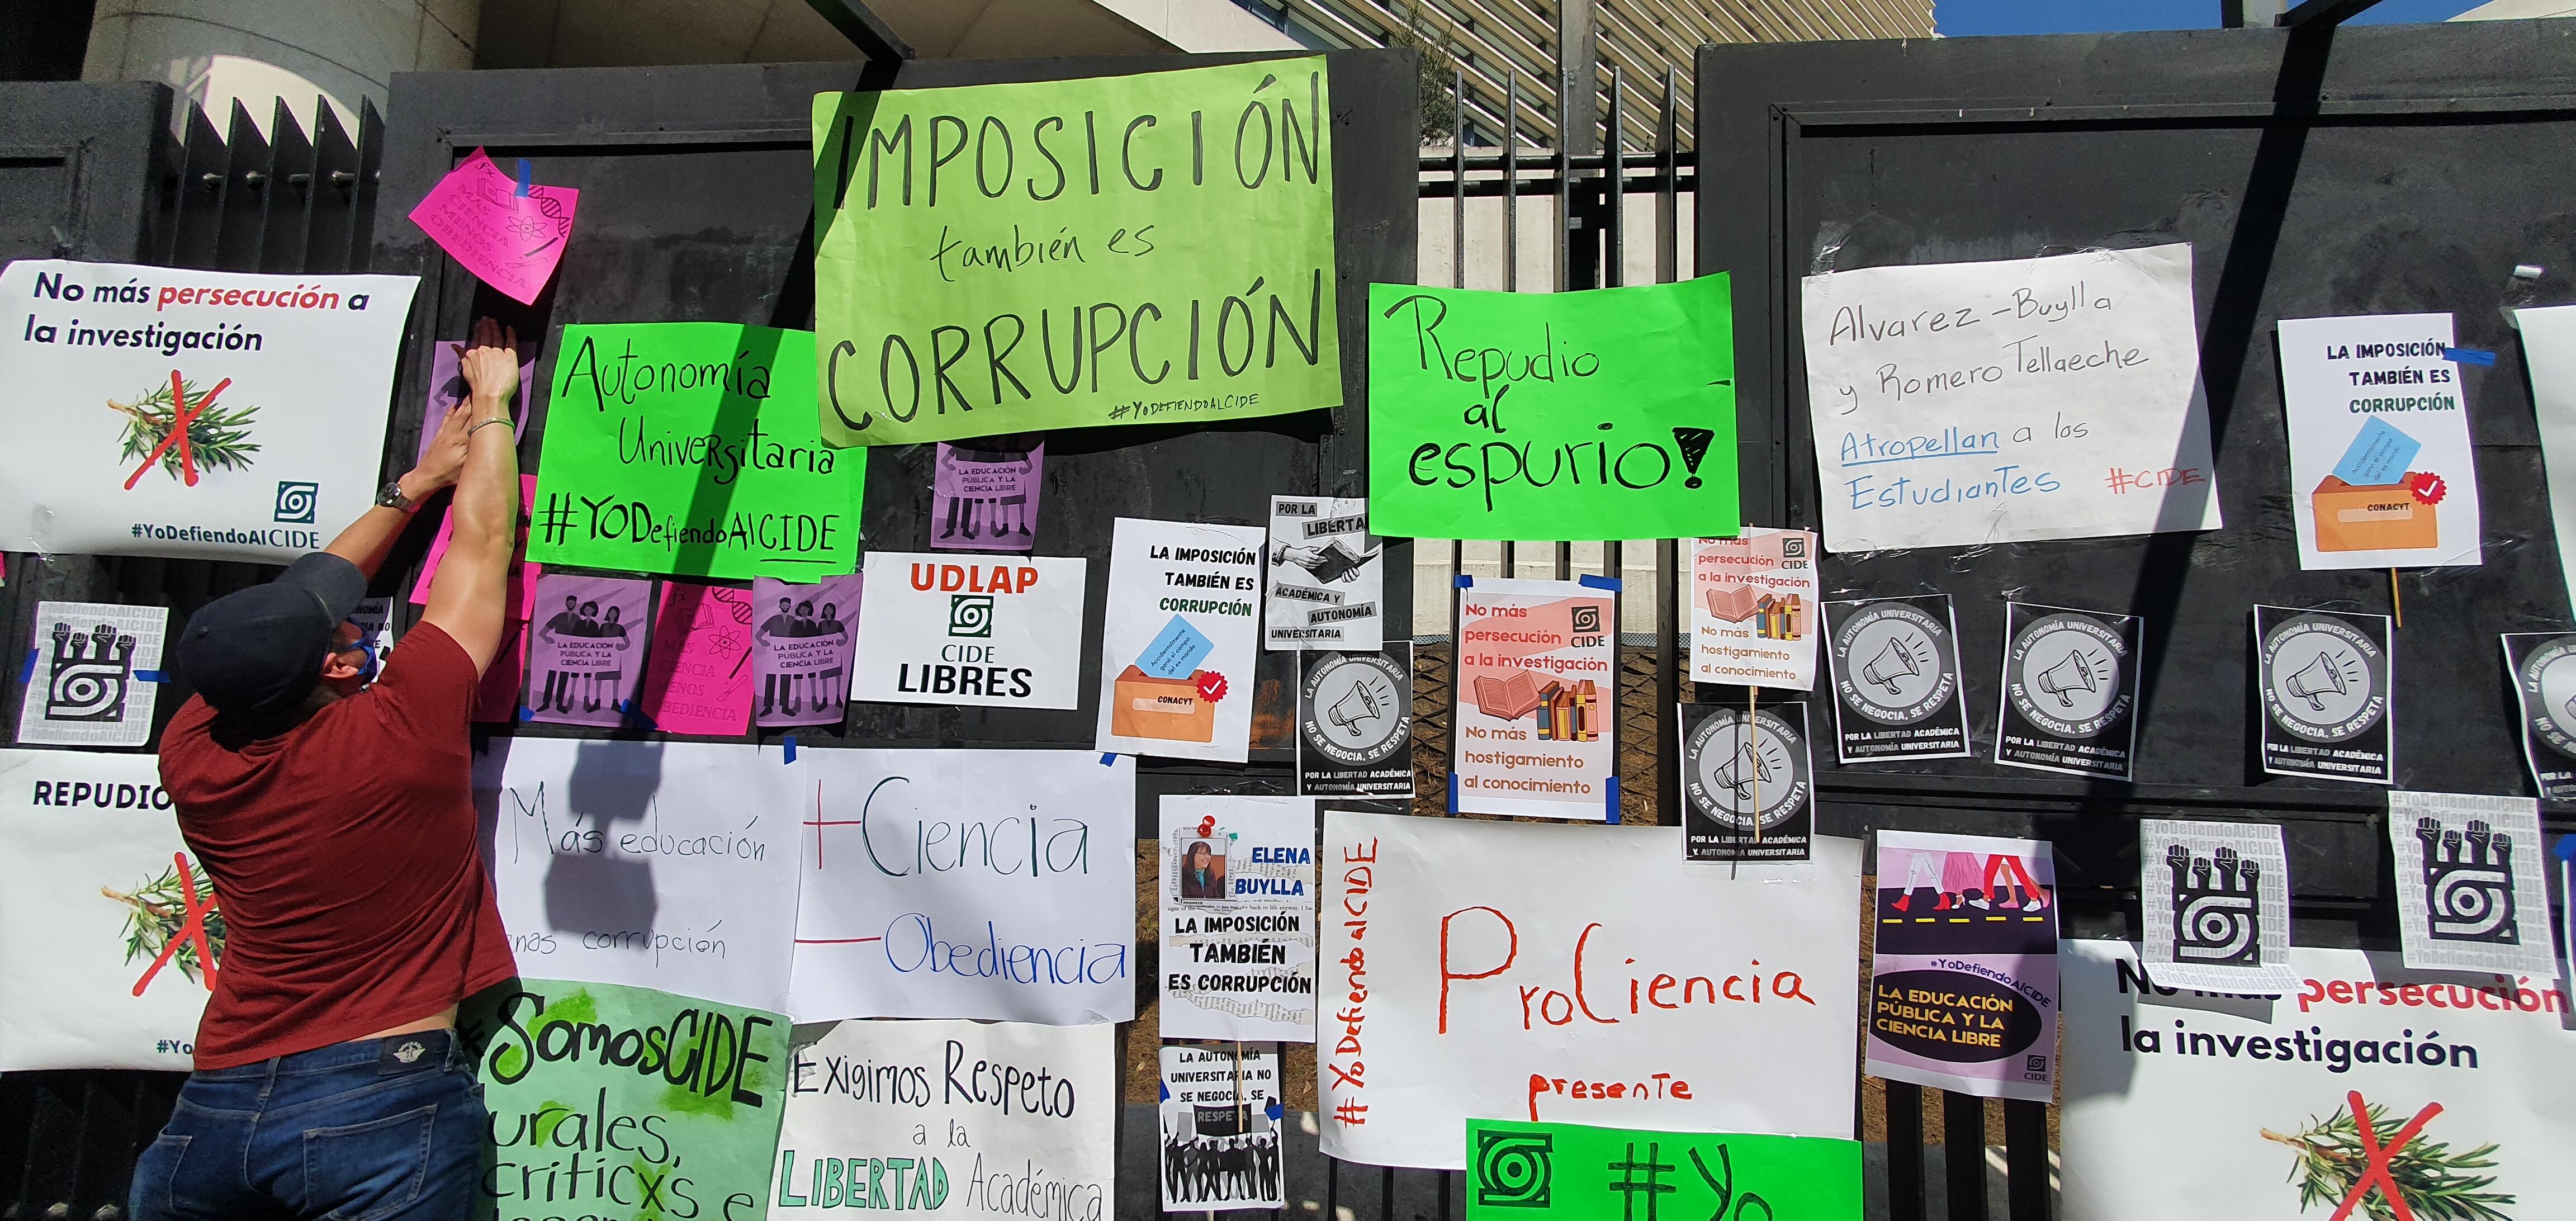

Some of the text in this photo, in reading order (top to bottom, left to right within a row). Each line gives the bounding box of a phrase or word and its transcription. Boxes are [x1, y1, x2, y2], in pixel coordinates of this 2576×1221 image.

[834, 71, 1319, 210] IMPOSICIÓN
[930, 225, 1156, 283] también es
[33, 272, 370, 311] No más persecución a
[23, 314, 262, 356] la investigación
[1829, 305, 1982, 346] Alvarez
[828, 269, 1321, 432] CORRUPCIÓN
[1384, 294, 1600, 399] Repudio
[2327, 338, 2446, 360] LA IMPOSICIÓN
[561, 336, 771, 413] Autonomía
[1839, 335, 2150, 416] y Romero Tellaeche
[2348, 366, 2450, 386] TAMBIÉN ES
[1464, 384, 1510, 434] al
[2349, 392, 2455, 413] CORRUPCIÓN
[1841, 411, 2089, 462] Atropellan a los
[972, 466, 1016, 475] EDUCACIÓN
[1408, 422, 1716, 513] espurio!
[2104, 466, 2205, 494] #CIDE
[1278, 503, 1315, 514] POR LA
[2367, 502, 2410, 512] CONACYT
[1150, 545, 1256, 565] LA IMPOSICIÓN
[1698, 555, 1774, 566] persecución
[1781, 560, 1808, 570] CIDE
[911, 562, 1038, 594] UDLAP
[1165, 571, 1254, 591] TAMBIÉN ES
[1275, 588, 1340, 603] ACADÉMICA Y
[1159, 598, 1252, 616] CORRUPCIÓN
[1311, 604, 1372, 623] AUTONOMÍA
[1466, 604, 1527, 618] No más
[789, 638, 834, 650] EDUCACIÓN
[1271, 630, 1341, 638] UNIVERSITARIA
[1464, 630, 1561, 645] persecución
[1571, 636, 1606, 649] CIDE
[1837, 609, 1943, 658] LA AUTONOMÍA UNIVERSITARIA
[778, 651, 813, 660] PÚBLICA
[941, 644, 995, 663] CIDE
[1151, 629, 1185, 667] Accidentalmente
[1176, 637, 1190, 653] compa
[1181, 645, 1195, 661] marido
[1701, 644, 1790, 660] hostigamiento
[1464, 654, 1608, 673] a la investigación
[1701, 664, 1796, 680] al conocimiento
[898, 663, 1033, 698] LIBRES
[1157, 695, 1194, 706] CONACYT
[2011, 683, 2131, 735] NO SE NEGOCIA, SE RESPETA
[1466, 726, 1527, 740] No más
[1465, 750, 1584, 770] hostigamiento
[1370, 768, 1411, 778] ACADÉMICA
[33, 780, 174, 811] REPUDIO
[1464, 776, 1590, 794] al conocimiento
[510, 781, 765, 864] Más educación
[1252, 847, 1311, 864] ELENA
[1235, 879, 1304, 896] BUYLLA
[1175, 911, 1300, 934] LA IMPOSICIÓN
[582, 920, 726, 968] corrupción
[1190, 940, 1286, 964] TAMBIÉN
[1168, 972, 1311, 994] ES CORRUPCIÓN
[1879, 985, 2013, 1012] LA EDUCACIÓN
[2296, 975, 2570, 1013] persecución
[1877, 1001, 2004, 1030] PÚBLICA Y LA
[1877, 1018, 2001, 1047] CIENCIA LIBRE
[2122, 1015, 2479, 1073] la investigación
[1180, 1053, 1194, 1063] LA
[793, 1040, 1075, 1118] Exigimos Respeto
[1257, 1069, 1271, 1080] NO
[2024, 1072, 2047, 1081] CIDE
[913, 1118, 971, 1148] a la
[778, 1149, 1103, 1221] LIBERTAD Académica
